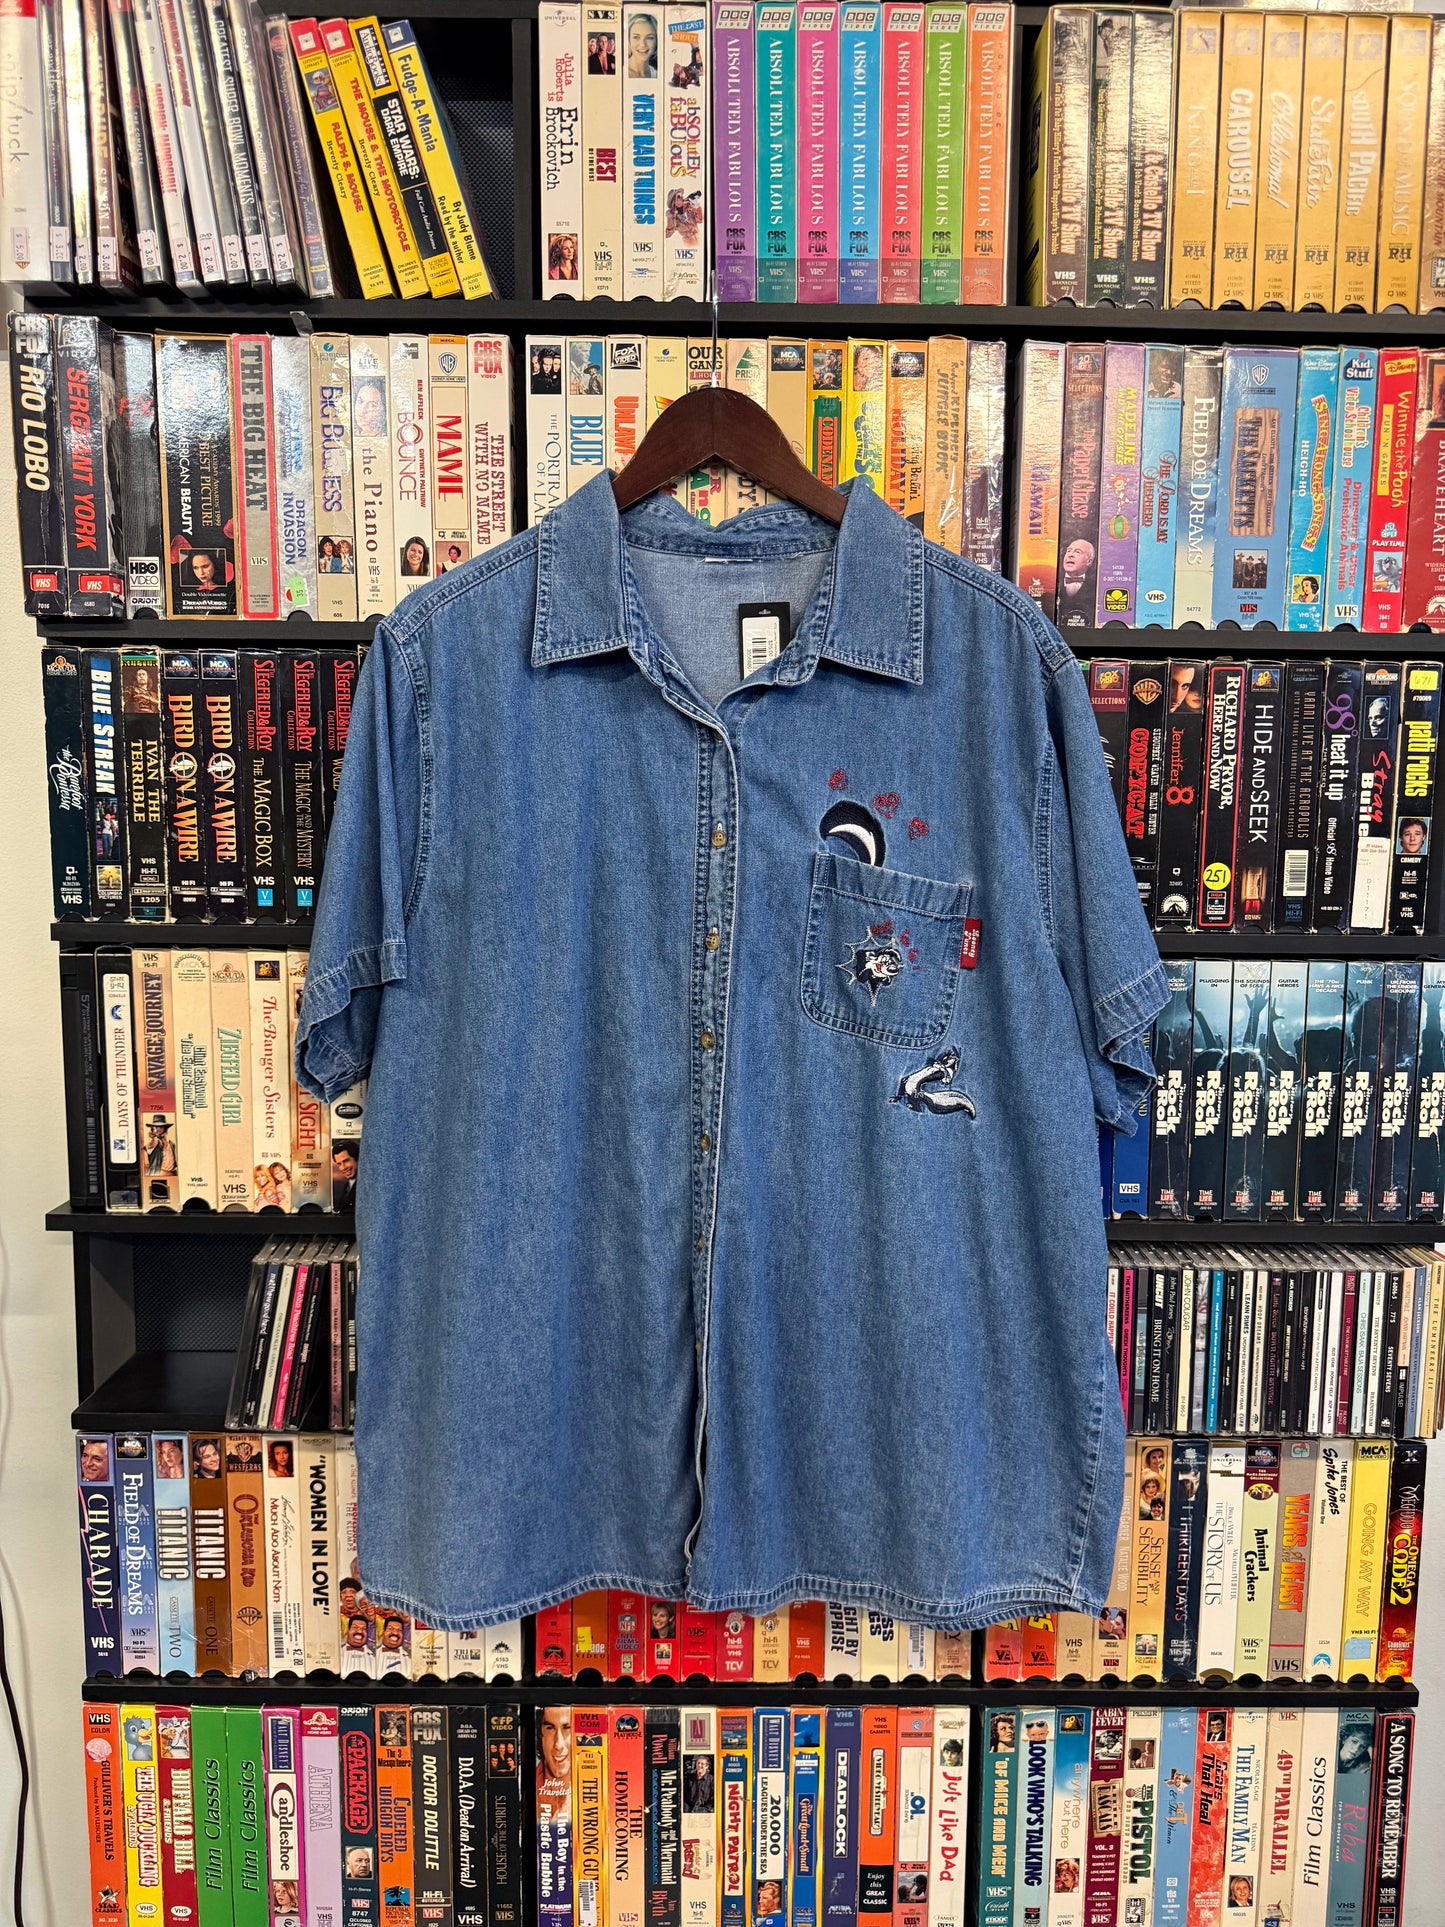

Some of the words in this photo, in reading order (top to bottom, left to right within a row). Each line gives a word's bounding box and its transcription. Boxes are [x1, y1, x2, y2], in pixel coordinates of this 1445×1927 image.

[720, 10, 750, 20] BBC
[214, 21, 234, 71] GREATEST
[225, 75, 239, 113] SUPER
[398, 54, 435, 152] Fudge-A-Mania
[726, 37, 741, 136] ABSOLUTELY
[228, 118, 243, 150] BOWL
[560, 108, 578, 165] Erin
[633, 94, 655, 131] VERY
[332, 122, 346, 157] RALPH
[380, 109, 396, 137] DARK
[390, 139, 408, 176] EMPIRE
[387, 98, 406, 133] STAR
[399, 136, 420, 179] WARS:
[545, 107, 560, 191] Brockovich
[633, 135, 655, 168] BAD
[1225, 88, 1254, 210] CAROUSEL
[233, 152, 254, 205] MOMENTS
[342, 160, 351, 172] S.
[728, 142, 741, 222] FABULOUS
[346, 172, 364, 213] MOUSE
[633, 169, 655, 225] THINGS
[453, 201, 461, 214] By
[457, 215, 467, 235] Judy
[463, 235, 476, 261] Blume
[633, 243, 653, 251] VHS
[726, 229, 745, 240] CBS
[726, 240, 745, 251] FOX
[178, 255, 188, 270] 2.00
[229, 253, 238, 268] 2.00
[240, 344, 262, 394] THE
[1347, 368, 1374, 378] Stuff
[1351, 359, 1371, 368] Kid
[20, 365, 46, 411] RIO
[242, 402, 266, 442] BIG
[475, 422, 488, 465] WITH
[570, 415, 603, 466] BLUE
[1193, 396, 1215, 456] FIELD
[23, 421, 50, 491] LOBO
[362, 448, 377, 475] the
[436, 415, 463, 502] MAME
[491, 435, 505, 467] THE
[1191, 458, 1207, 478] OF
[244, 449, 267, 511] HEAT
[476, 468, 489, 490] NO
[491, 468, 505, 533] STREET
[1432, 440, 1445, 555] BRAVEHEART
[74, 493, 97, 551] YORK
[180, 488, 193, 535] BEAUTY
[282, 492, 296, 565] INVASION
[296, 499, 307, 559] DRAGON
[364, 483, 383, 551] Piano
[477, 495, 491, 545] NAME
[1187, 483, 1212, 565] DREAMS
[130, 562, 158, 574] HBO
[130, 576, 159, 585] VIDEO
[91, 670, 114, 722] BLUE
[1213, 694, 1225, 733] HERE
[1223, 676, 1241, 750] RICHARD
[168, 695, 195, 748] BIRD
[1253, 705, 1274, 754] HIDE
[1405, 721, 1435, 752] patti
[95, 726, 116, 795] STREAK
[147, 740, 158, 781] IVAN
[1170, 727, 1184, 784] Jennifer
[1212, 738, 1220, 758] AND
[1332, 735, 1350, 766] heat
[131, 740, 145, 823] TERRIBLE
[1126, 728, 1150, 840] COPYCAT
[1166, 785, 1193, 805] 8
[1210, 759, 1223, 791] NOW
[1220, 754, 1237, 810] PRYOR,
[1252, 758, 1266, 789] AND
[1328, 782, 1344, 801] up
[1330, 768, 1349, 781] it
[1405, 756, 1434, 797] rocks
[148, 785, 160, 823] THE
[254, 781, 272, 834] MAGIC
[1249, 790, 1270, 843] SEEK
[173, 813, 199, 863] WIRE
[254, 837, 272, 868] BOX
[1206, 870, 1226, 882] 251
[115, 1028, 126, 1078] THUNDER
[218, 1028, 242, 1090] ZIEGFELD
[118, 1083, 128, 1096] OF
[221, 1093, 242, 1127] GIRL
[263, 1088, 280, 1139] Sisters
[119, 1101, 129, 1128] DAYS
[224, 1184, 246, 1192] VHS
[1154, 1320, 1162, 1352] BRING
[1154, 1352, 1160, 1360] IT
[1429, 1321, 1437, 1375] LUMINEERS
[1152, 1373, 1160, 1402] HOME
[1153, 1361, 1160, 1370] ON
[309, 1455, 327, 1531] "WOMEN
[87, 1493, 113, 1609] CHARADE
[157, 1508, 189, 1580] TITANIC
[312, 1540, 327, 1557] IN
[1254, 1529, 1269, 1571] Animal
[1361, 1504, 1377, 1554] GOING
[312, 1562, 330, 1615] LOVE"
[1245, 1551, 1259, 1602] Crackers
[1361, 1561, 1373, 1583] MY
[1356, 1585, 1371, 1617] WAY
[170, 1624, 181, 1658] TWO
[1274, 1660, 1299, 1670] VHS
[726, 1661, 743, 1670] TCV
[90, 1714, 111, 1723] VHS
[423, 1755, 438, 1805] DOCTOR
[1028, 1740, 1046, 1778] LOOK
[101, 1760, 111, 1816] GULLIVER'S
[205, 1759, 220, 1840] Classics
[351, 1748, 367, 1827] PACKAGE
[836, 1751, 847, 1855] DEADLOCK
[1027, 1780, 1044, 1828] WHO'S
[1232, 1777, 1252, 1826] FAMILY
[103, 1818, 114, 1860] TRAVELS
[425, 1809, 439, 1870] DOLITTLE
[540, 1804, 552, 1849] Plastic
[615, 1771, 628, 1881] HOMECOMING
[770, 1796, 780, 1855] 20,000
[1129, 1800, 1153, 1883] PISTOL
[1231, 1828, 1250, 1863] MAN
[1271, 1787, 1291, 1874] PARALLEL
[1382, 1799, 1400, 1878] REMEMBER
[205, 1848, 222, 1890] Film
[541, 1852, 552, 1898] Bubble
[1025, 1830, 1043, 1886] TALKING
